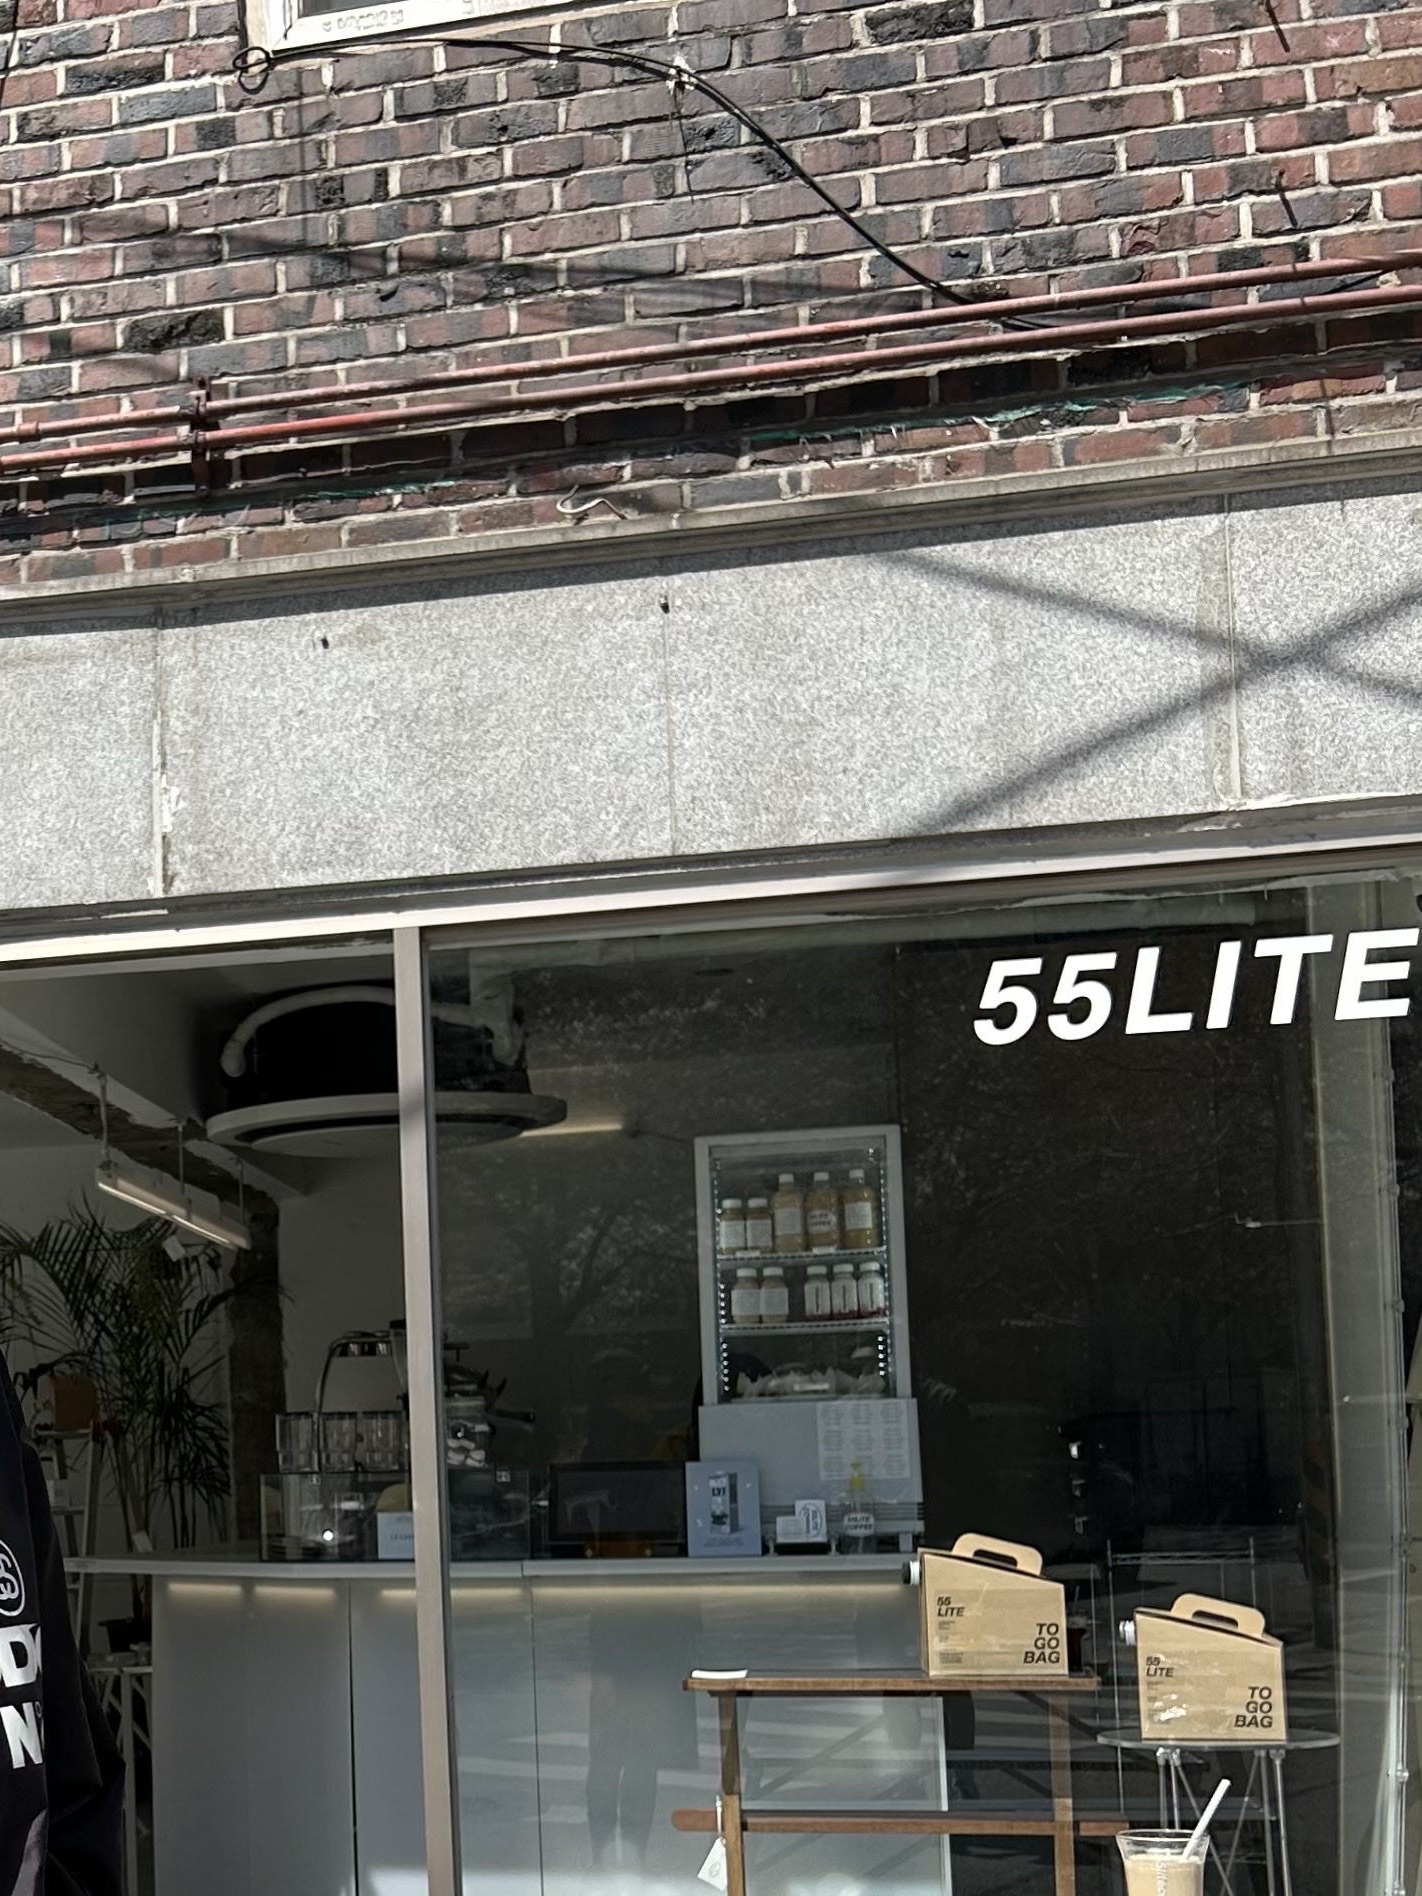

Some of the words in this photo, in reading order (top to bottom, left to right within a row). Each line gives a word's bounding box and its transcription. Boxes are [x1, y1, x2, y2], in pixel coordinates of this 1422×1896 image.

[973, 927, 1420, 1046] 55LITE
[937, 1606, 965, 1617] LITE
[1036, 1622, 1059, 1636] TO
[1034, 1636, 1060, 1650] GO
[1023, 1651, 1061, 1664] BAG
[1146, 1667, 1175, 1678] LITE
[1248, 1686, 1272, 1700] TO
[1245, 1701, 1273, 1714] GO
[1234, 1714, 1273, 1728] BAG
